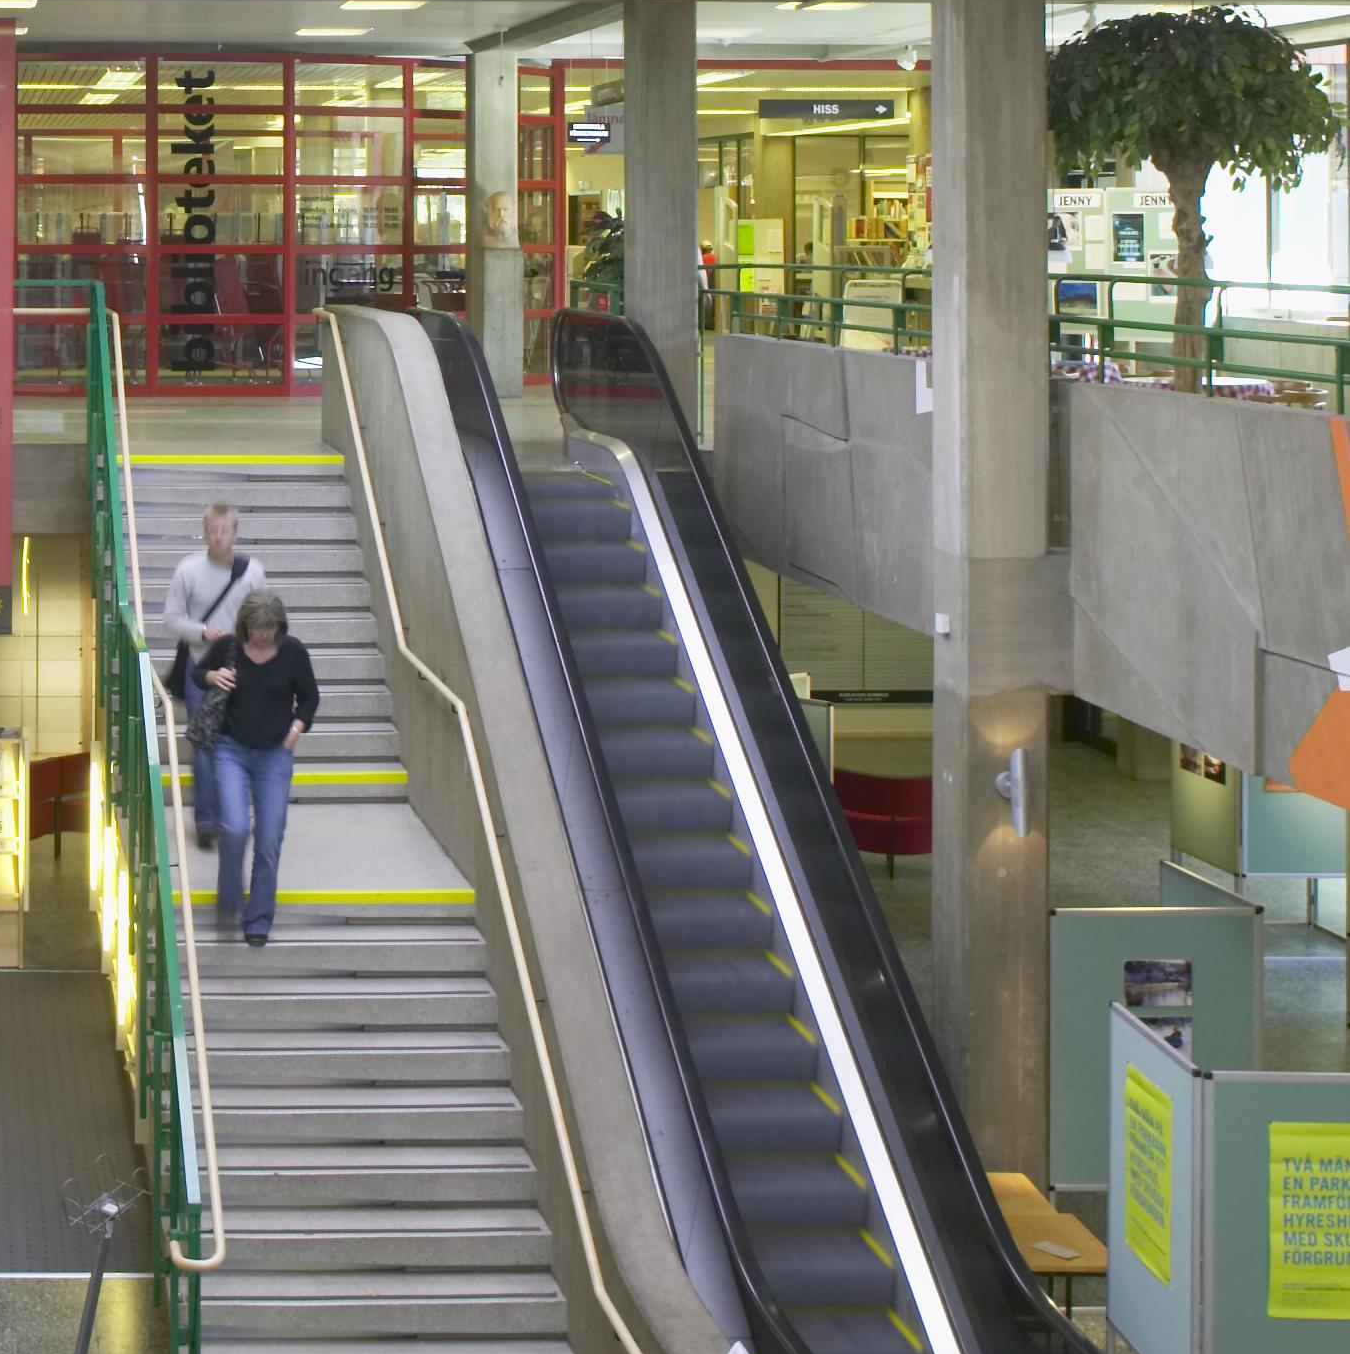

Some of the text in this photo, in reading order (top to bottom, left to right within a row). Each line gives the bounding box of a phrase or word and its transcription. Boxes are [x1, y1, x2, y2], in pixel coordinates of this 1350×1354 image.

[813, 104, 840, 115] HISS
[1059, 195, 1092, 206] JENNY
[1282, 1154, 1313, 1173] TVÅ
[1283, 1176, 1304, 1191] EN
[1283, 1213, 1350, 1229] HYRESH
[1283, 1232, 1318, 1247] MED
